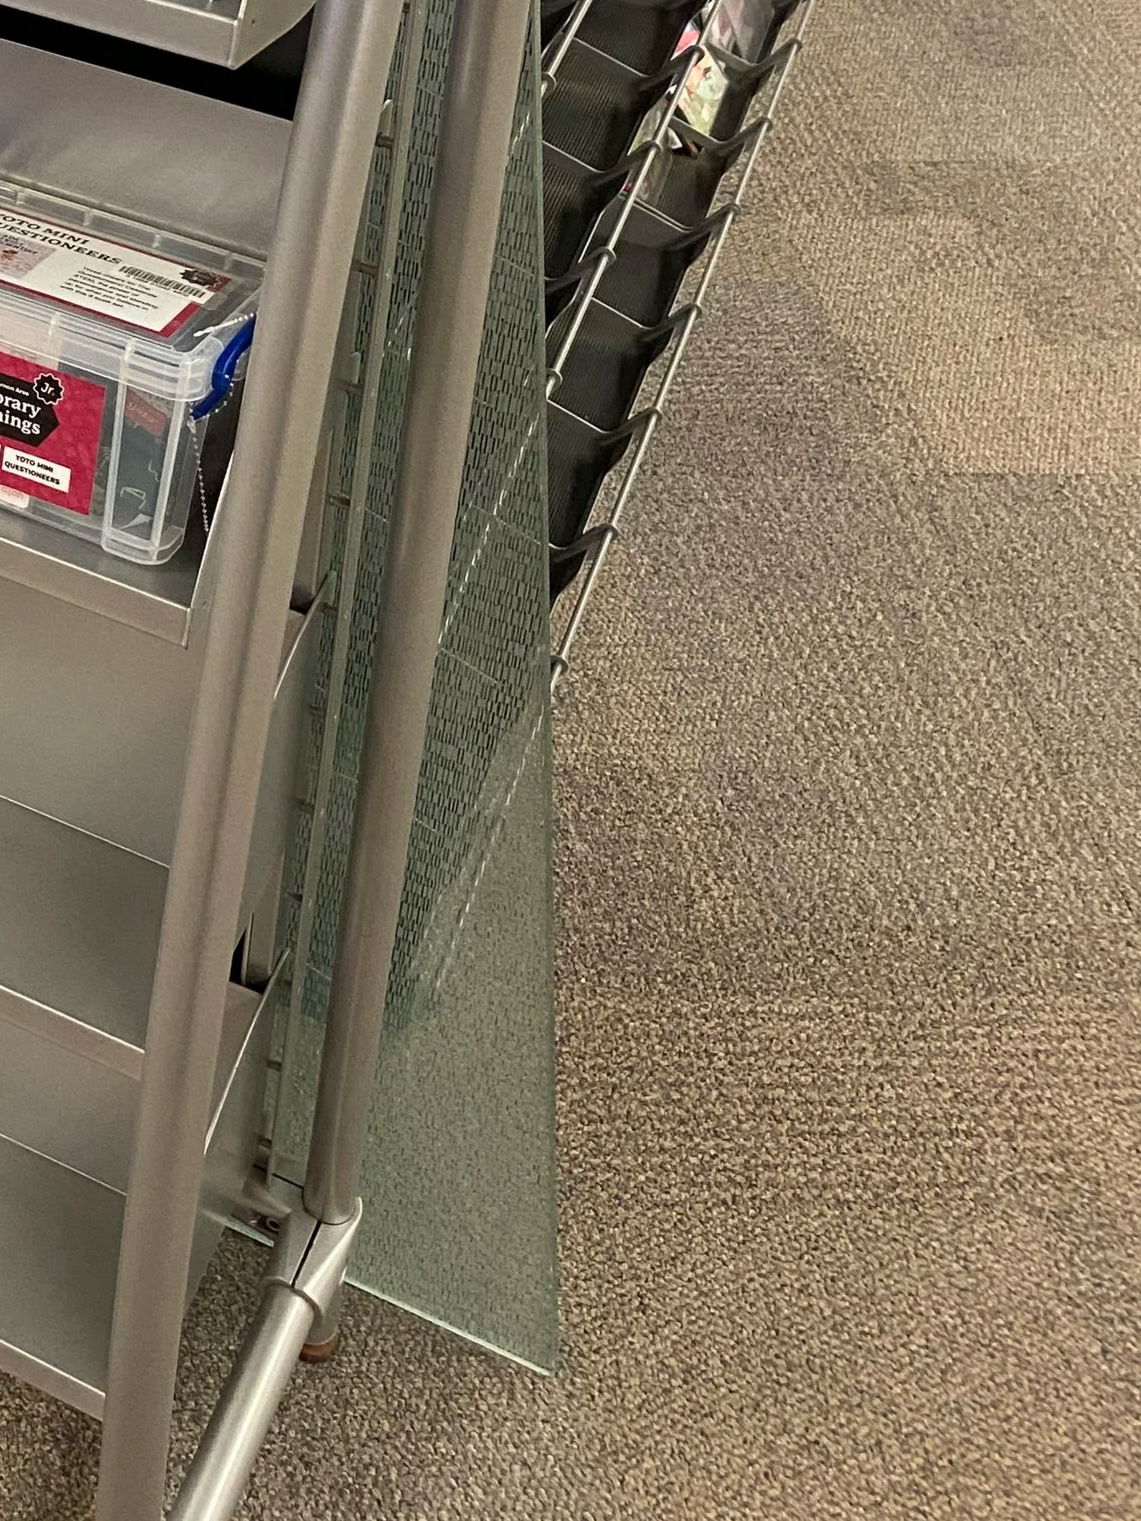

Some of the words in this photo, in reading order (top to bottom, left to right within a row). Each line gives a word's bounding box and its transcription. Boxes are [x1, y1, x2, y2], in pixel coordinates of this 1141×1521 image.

[43, 227, 90, 245] MINI
[40, 382, 55, 396] Jr.
[16, 454, 36, 466] YOTO
[4, 461, 60, 485] QUESTIONEERS
